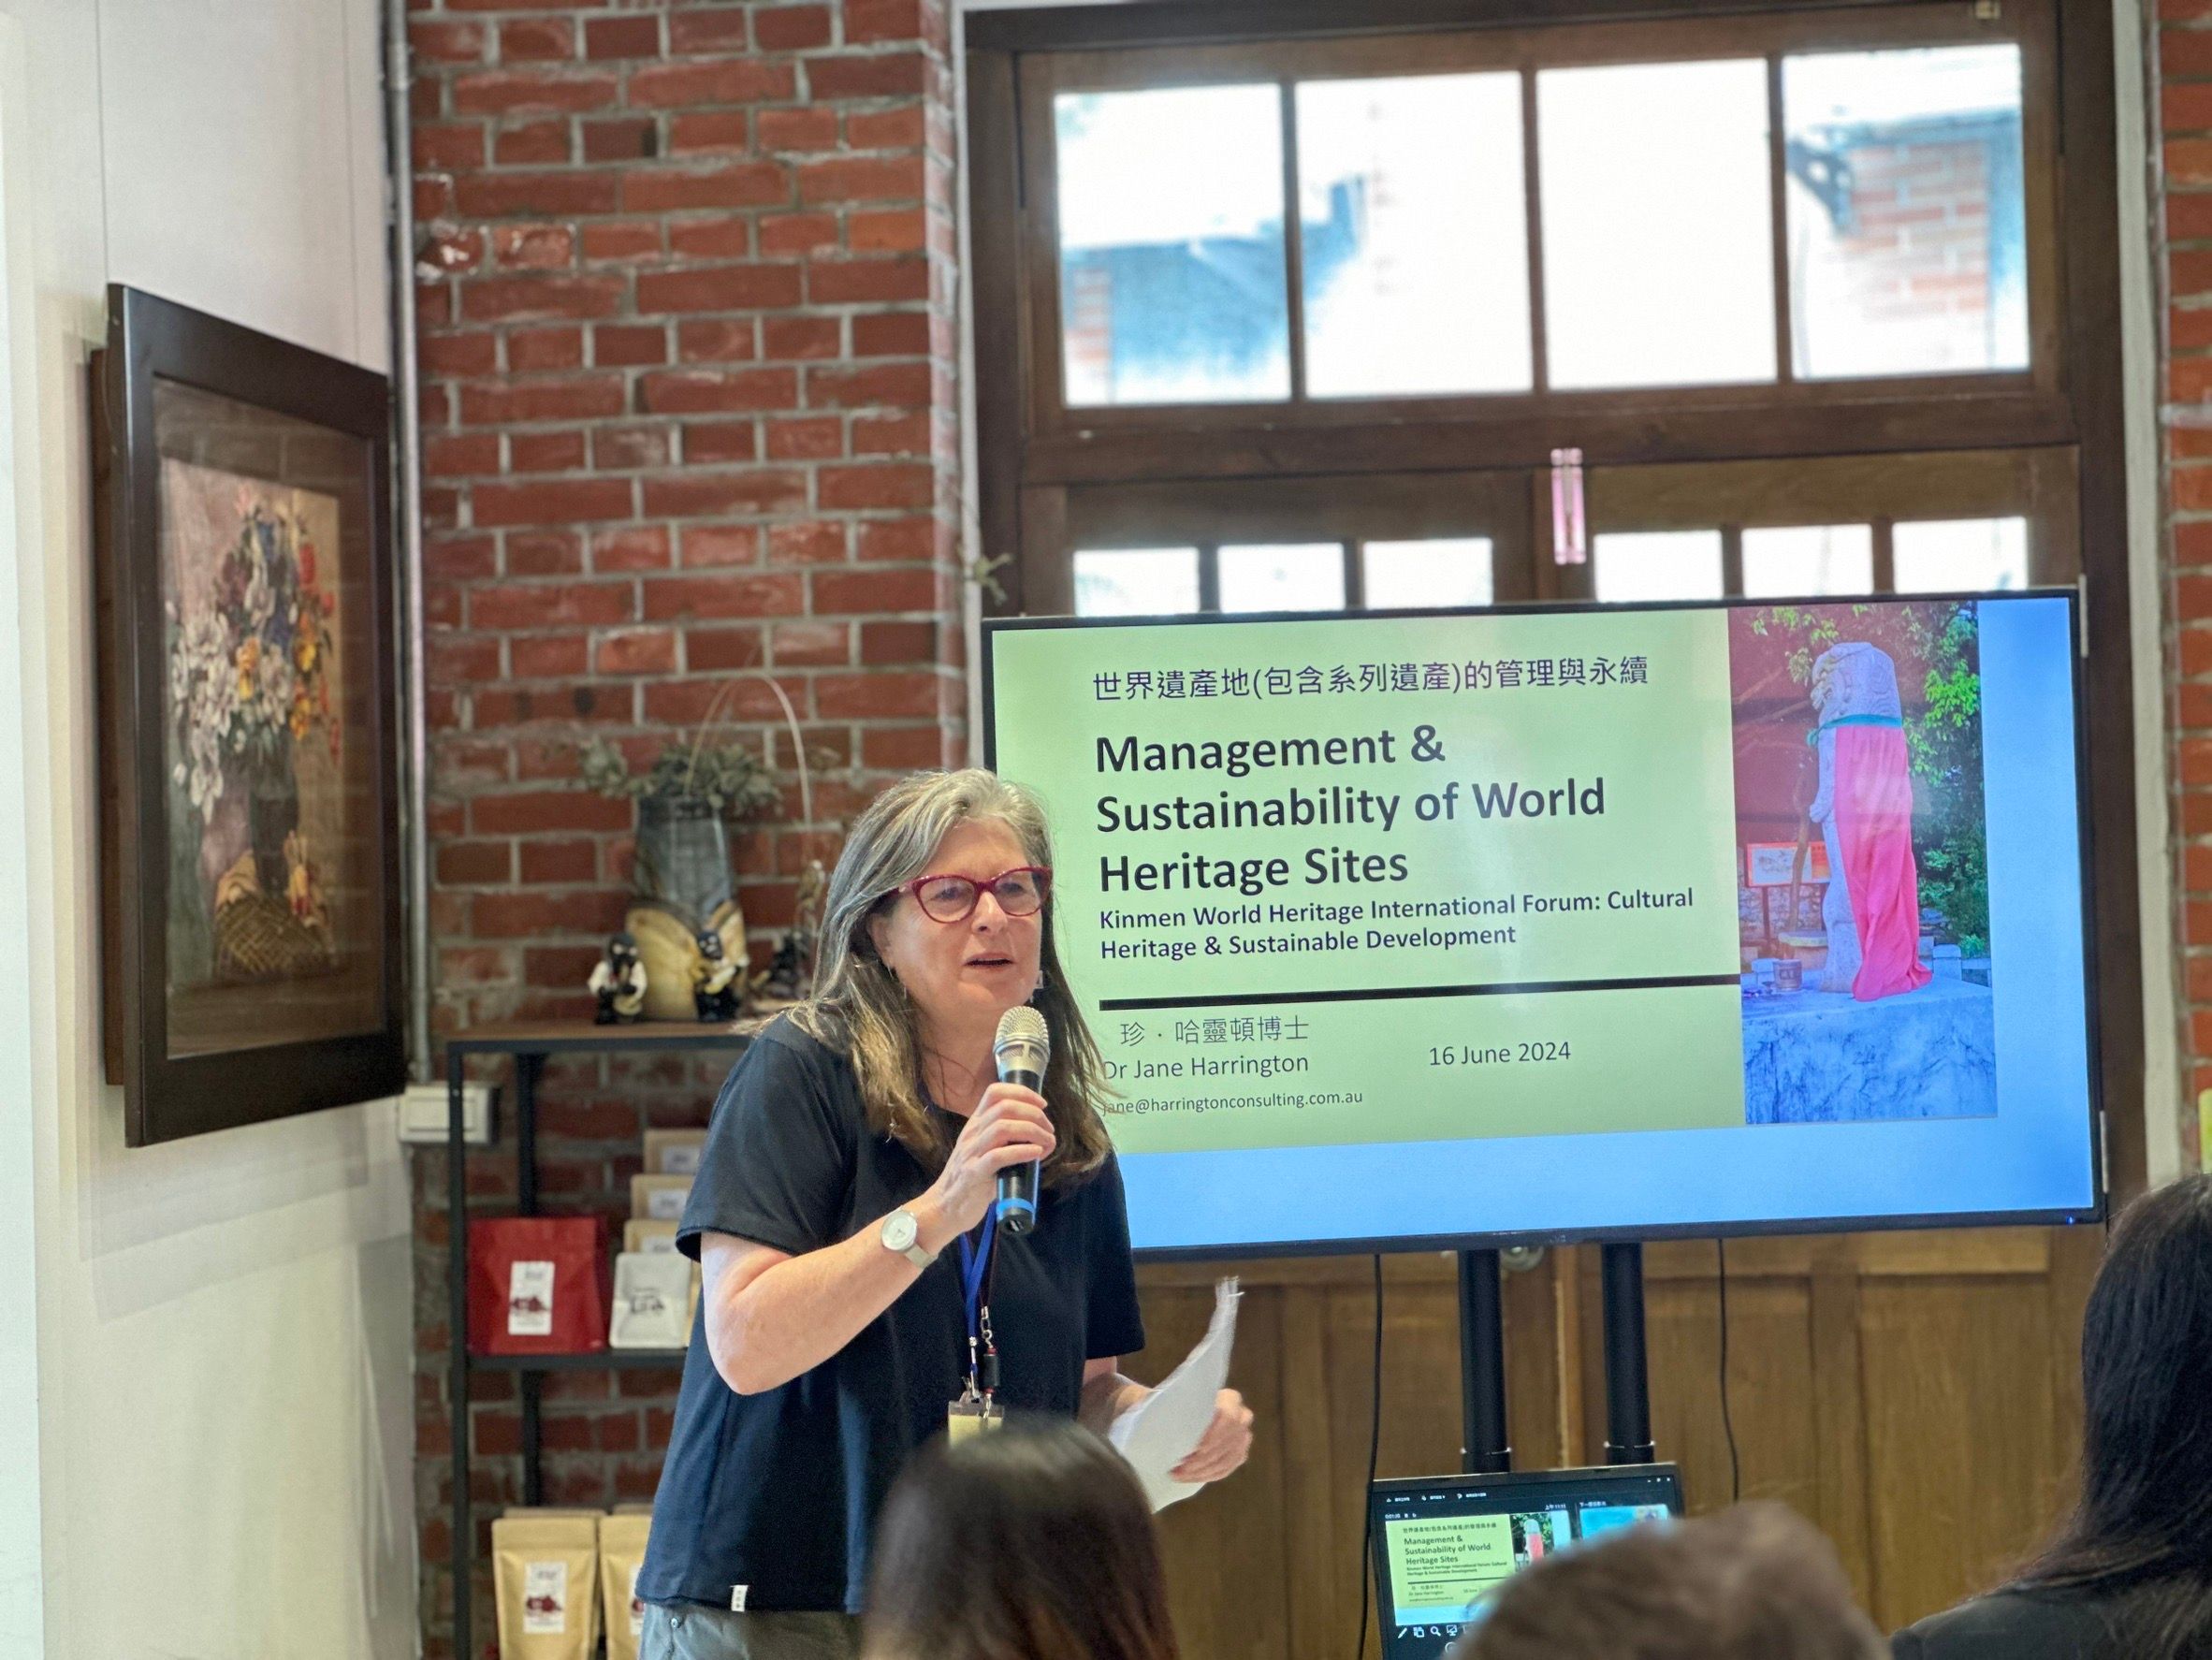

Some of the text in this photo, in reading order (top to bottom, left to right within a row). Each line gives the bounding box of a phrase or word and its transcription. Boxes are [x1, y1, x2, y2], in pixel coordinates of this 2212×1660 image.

[1093, 656, 1648, 700] 世界遺產地(包含系列遺產)的管理與永續
[1097, 725, 1446, 778] Management &
[1098, 777, 1604, 832] Sustainability of World
[1100, 846, 1408, 896] Heritage Sites
[1100, 887, 1693, 929] Kinmen World Heritage International Forum: Cultural
[1101, 926, 1516, 961] Heritage & Sustainable Development
[1103, 1055, 1308, 1079] Dr Jane Harrington
[1430, 1041, 1571, 1066] 16 June 2024
[1404, 1536, 1454, 1545] Management
[1405, 1547, 1456, 1555] Sustainability
